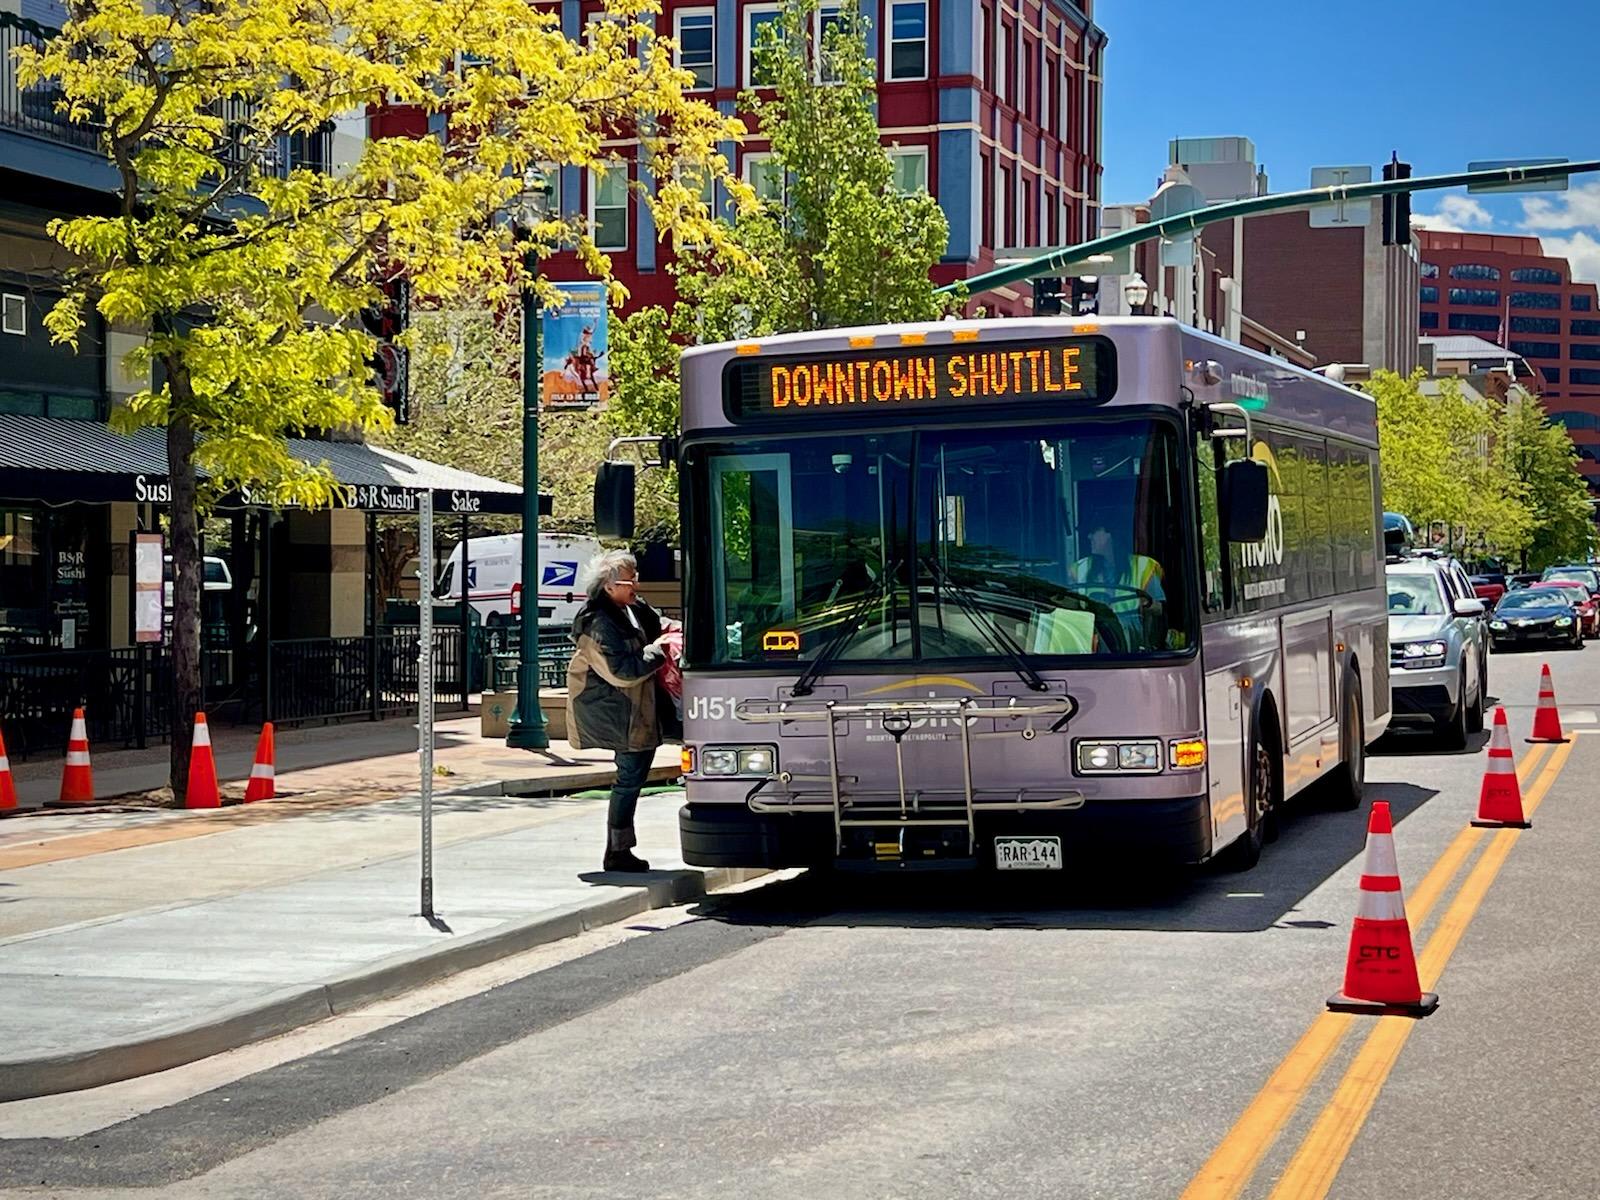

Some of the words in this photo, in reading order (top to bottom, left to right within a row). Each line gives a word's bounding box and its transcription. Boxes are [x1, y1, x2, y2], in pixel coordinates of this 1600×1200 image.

[771, 357, 937, 408] DOWNTOWN
[947, 347, 1082, 397] SHUTTLE
[381, 486, 415, 511] Sushi
[451, 490, 481, 513] Sake
[57, 567, 86, 580] Sushi
[688, 696, 737, 721] J151
